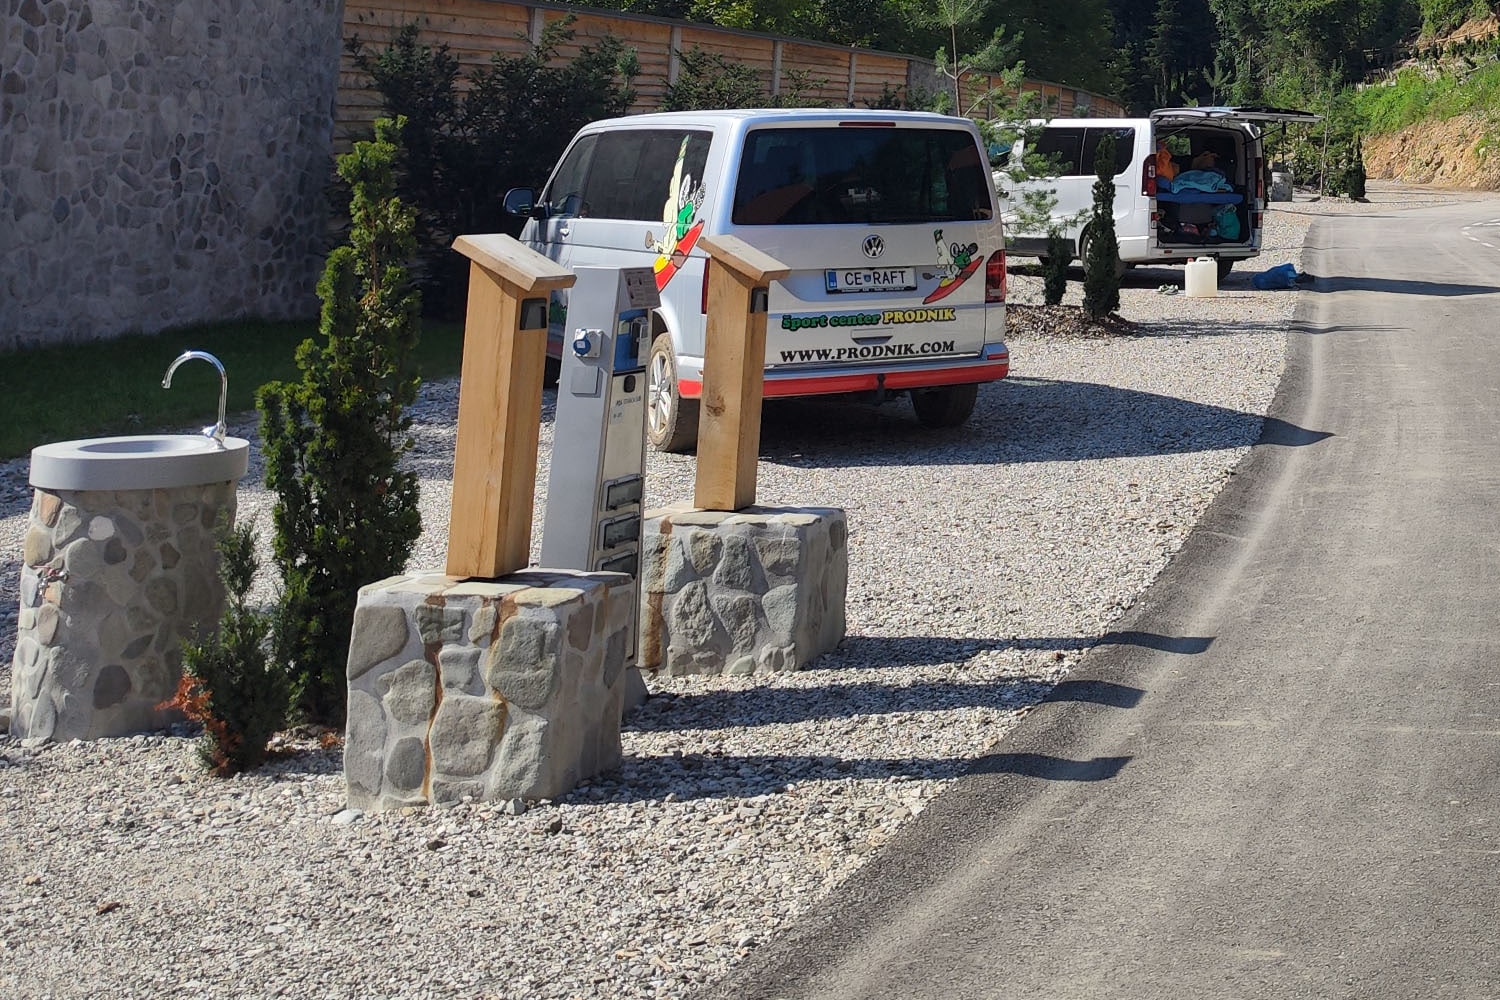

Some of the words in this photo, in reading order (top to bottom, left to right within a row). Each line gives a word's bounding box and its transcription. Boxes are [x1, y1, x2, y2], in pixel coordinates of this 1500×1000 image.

[844, 272, 863, 286] CE
[872, 271, 906, 284] RAFT
[829, 313, 881, 328] center
[883, 308, 956, 324] PRODNIK
[780, 341, 955, 362] WWW.PRODNIK.COM
